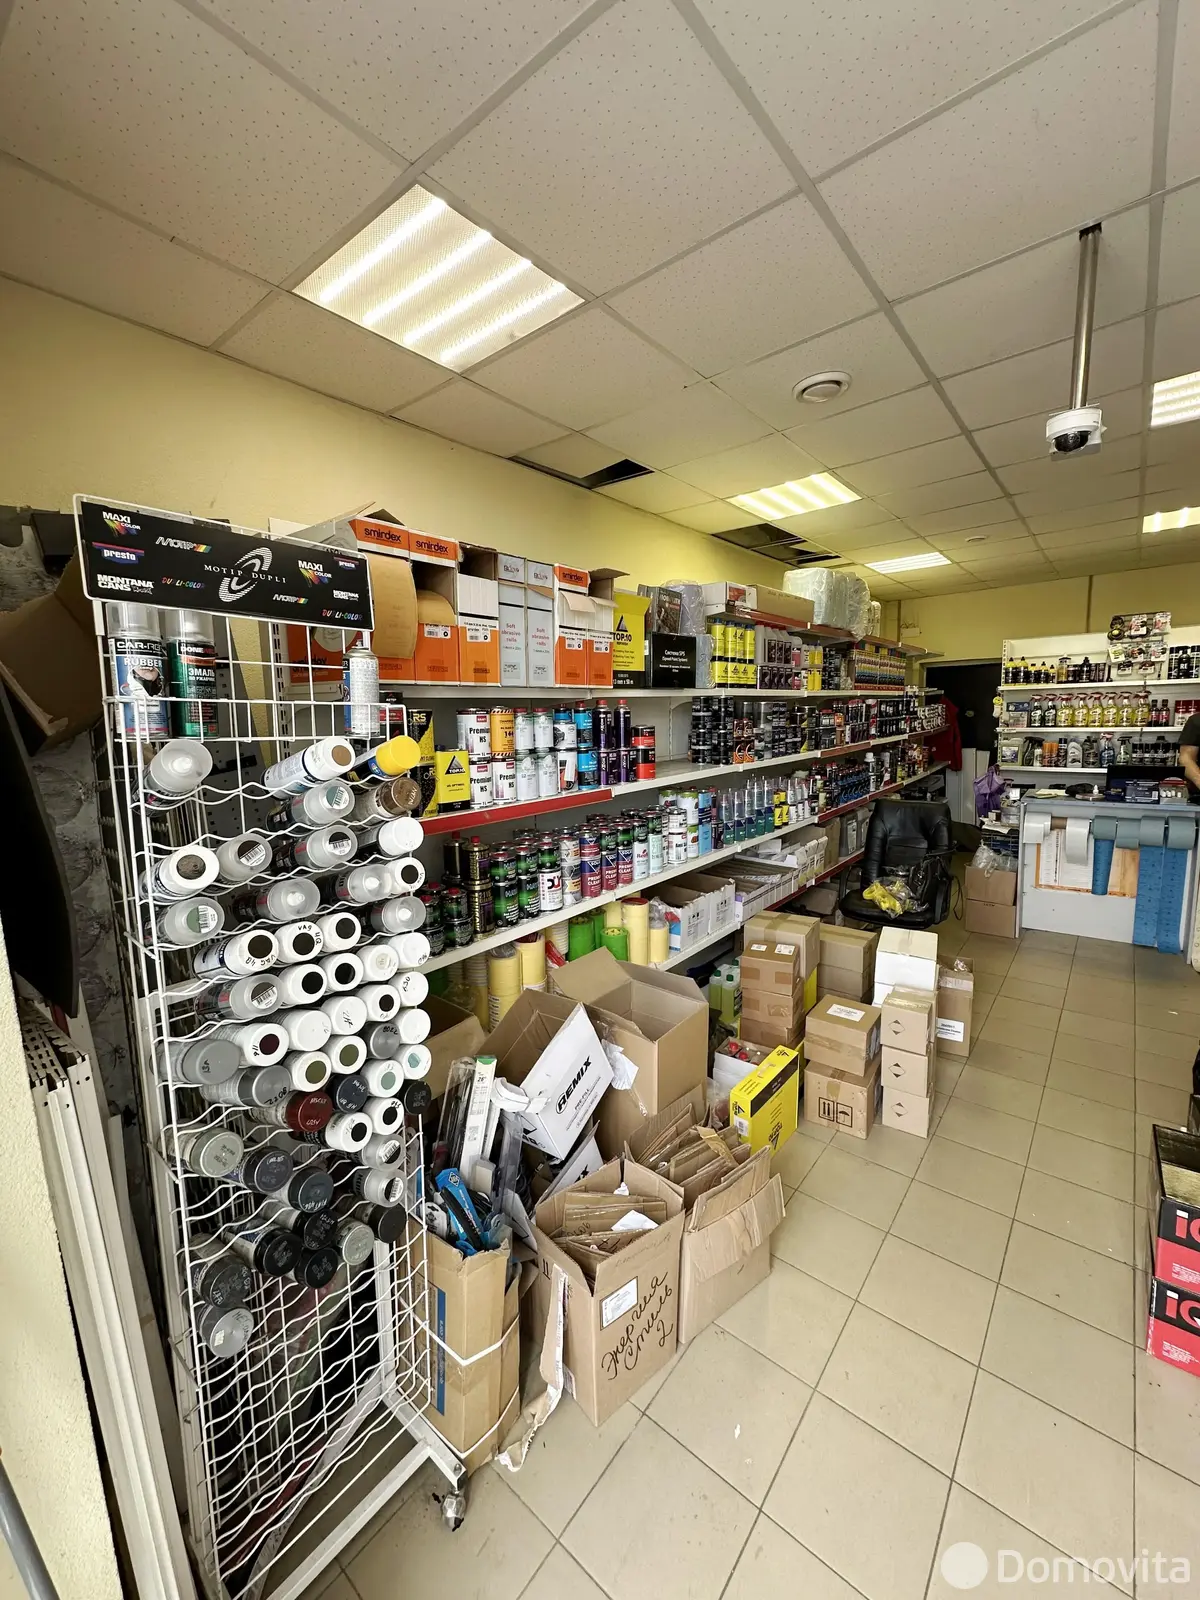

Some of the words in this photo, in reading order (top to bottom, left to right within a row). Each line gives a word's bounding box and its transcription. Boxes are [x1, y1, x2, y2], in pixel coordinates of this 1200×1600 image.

[102, 511, 131, 523] MAXI
[120, 522, 141, 530] COLOR
[364, 527, 402, 542] smirdex
[416, 540, 449, 553] smirdex
[103, 548, 136, 560] presto
[297, 559, 324, 571] MAXI
[204, 564, 243, 576] MOTIP
[251, 572, 287, 584] DUPLI
[314, 570, 333, 578] COLOR
[97, 574, 154, 589] MONTANA
[98, 581, 132, 592] CANS
[161, 577, 206, 589] DULI-COLOR
[188, 668, 216, 677] ЭМАЛЬ
